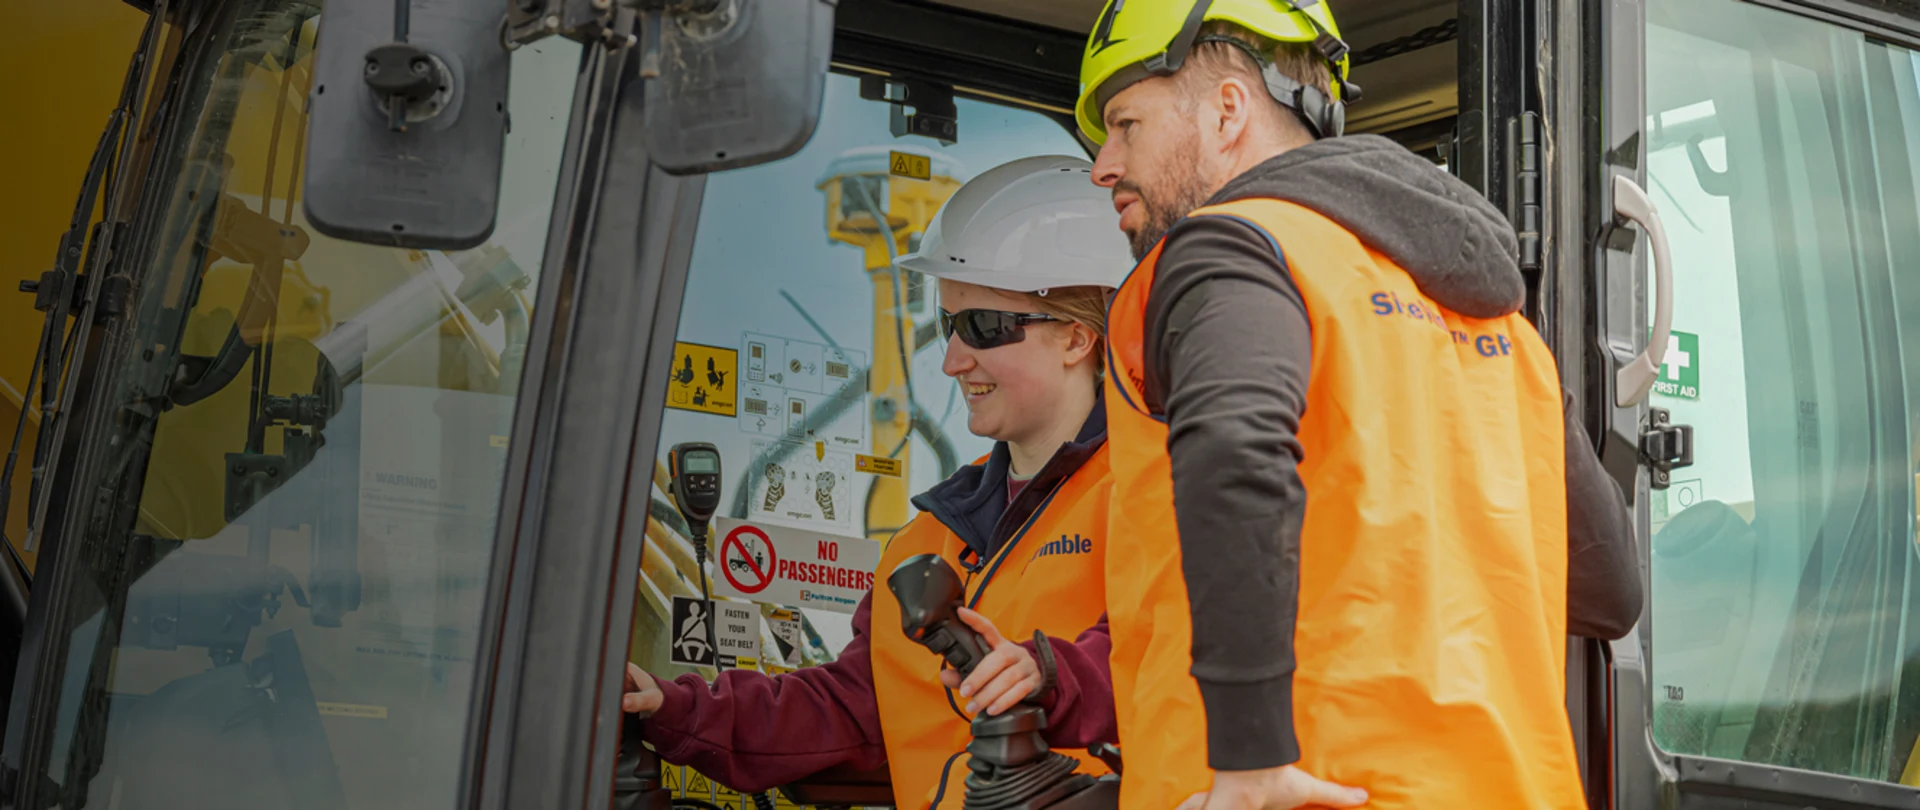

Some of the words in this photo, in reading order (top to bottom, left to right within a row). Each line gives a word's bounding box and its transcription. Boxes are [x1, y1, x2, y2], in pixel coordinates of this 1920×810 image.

[1652, 381, 1679, 395] FIRST
[1680, 386, 1697, 397] AID
[834, 435, 860, 445] engcon
[376, 472, 438, 490] WARNING
[787, 511, 812, 520] engcon
[817, 540, 838, 562] NO
[779, 559, 874, 591] PASSENGERS
[725, 608, 750, 620] FASTEN
[728, 624, 746, 634] YOUR
[720, 637, 736, 648] SEAT
[737, 639, 754, 649] BELT
